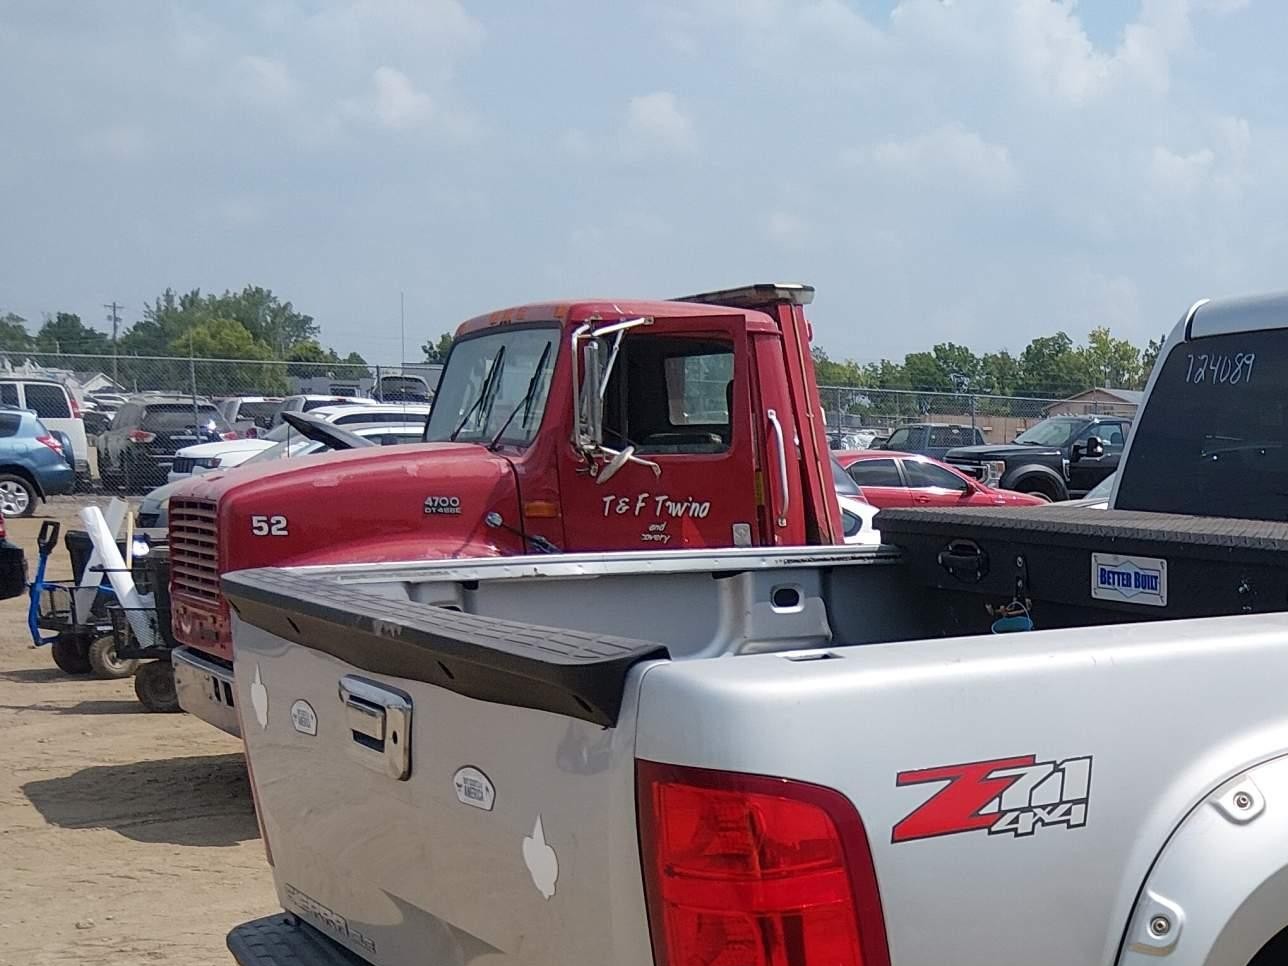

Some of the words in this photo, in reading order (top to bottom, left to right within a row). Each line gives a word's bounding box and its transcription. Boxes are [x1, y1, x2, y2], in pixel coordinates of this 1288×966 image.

[424, 496, 460, 507] 4700
[252, 515, 289, 536] 52
[1100, 567, 1132, 588] BETTER
[1134, 571, 1159, 591] BUILT
[890, 753, 1093, 844] Z71
